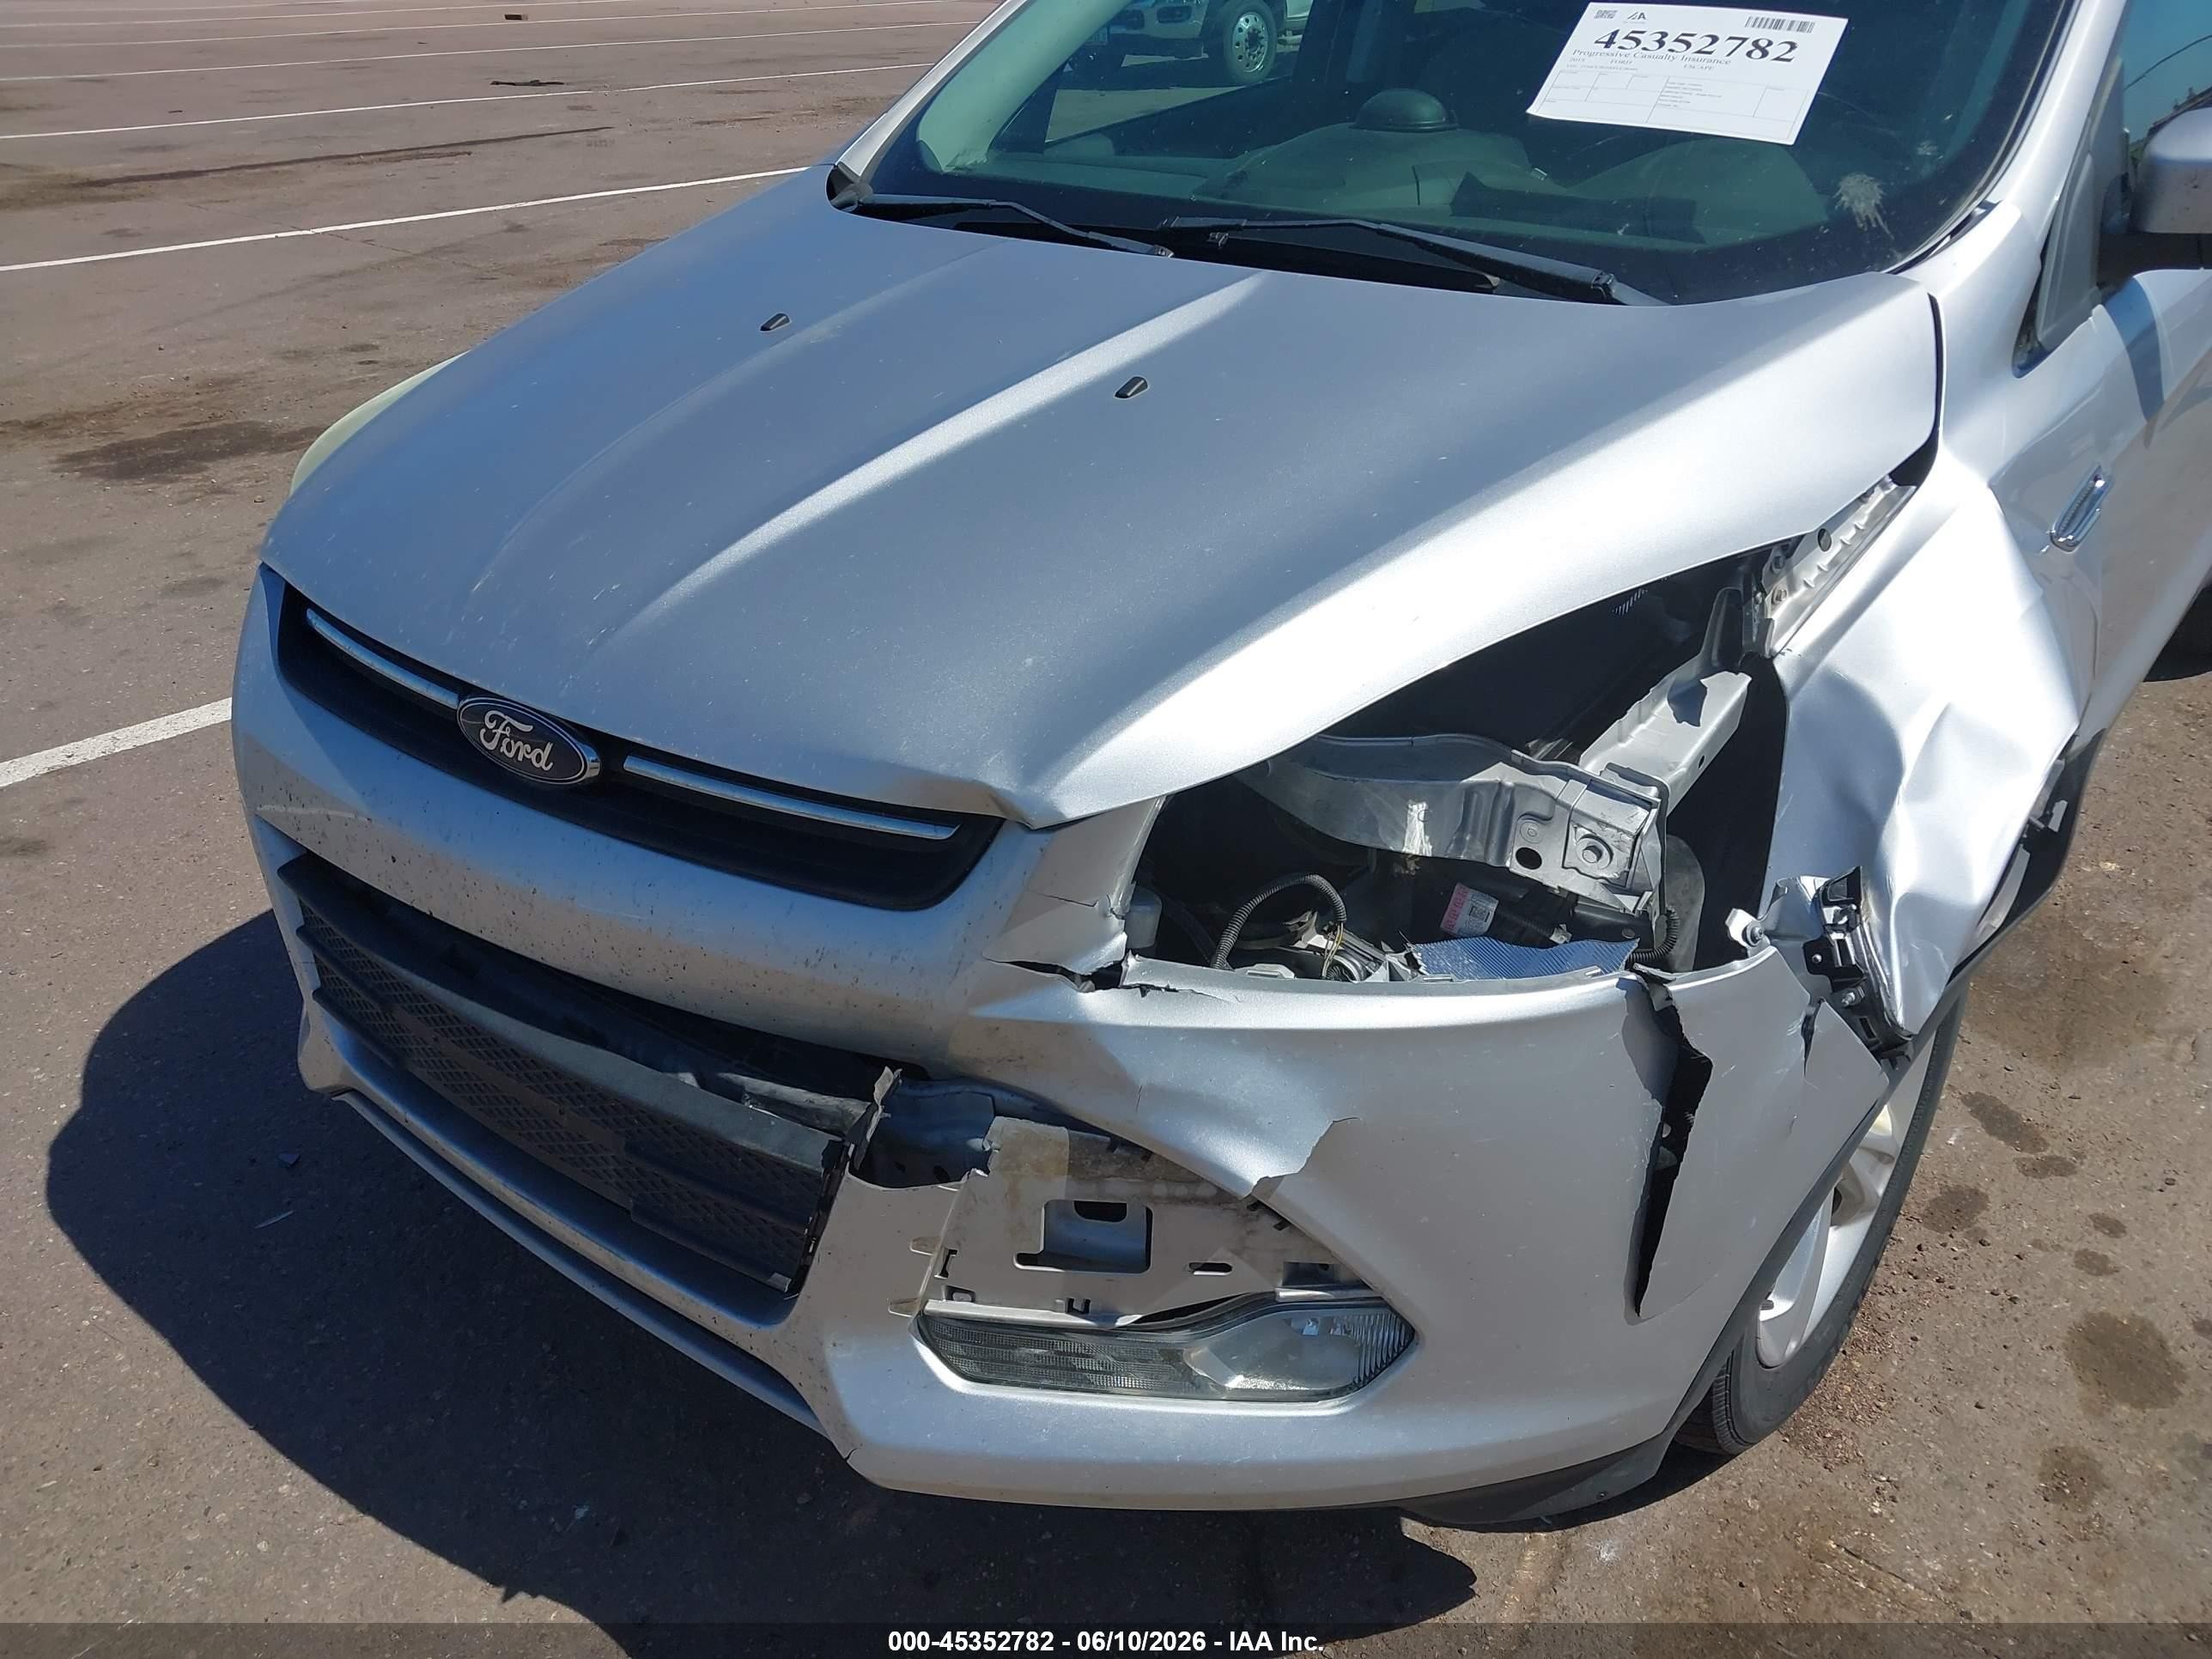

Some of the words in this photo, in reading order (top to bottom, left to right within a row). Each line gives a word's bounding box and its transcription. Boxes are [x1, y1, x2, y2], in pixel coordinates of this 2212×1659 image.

[1572, 49, 1631, 58] Progressive
[1633, 52, 1677, 63] Casualty
[1680, 55, 1732, 65] Insurance
[1594, 28, 1799, 63] 45352782
[480, 710, 554, 771] Ford
